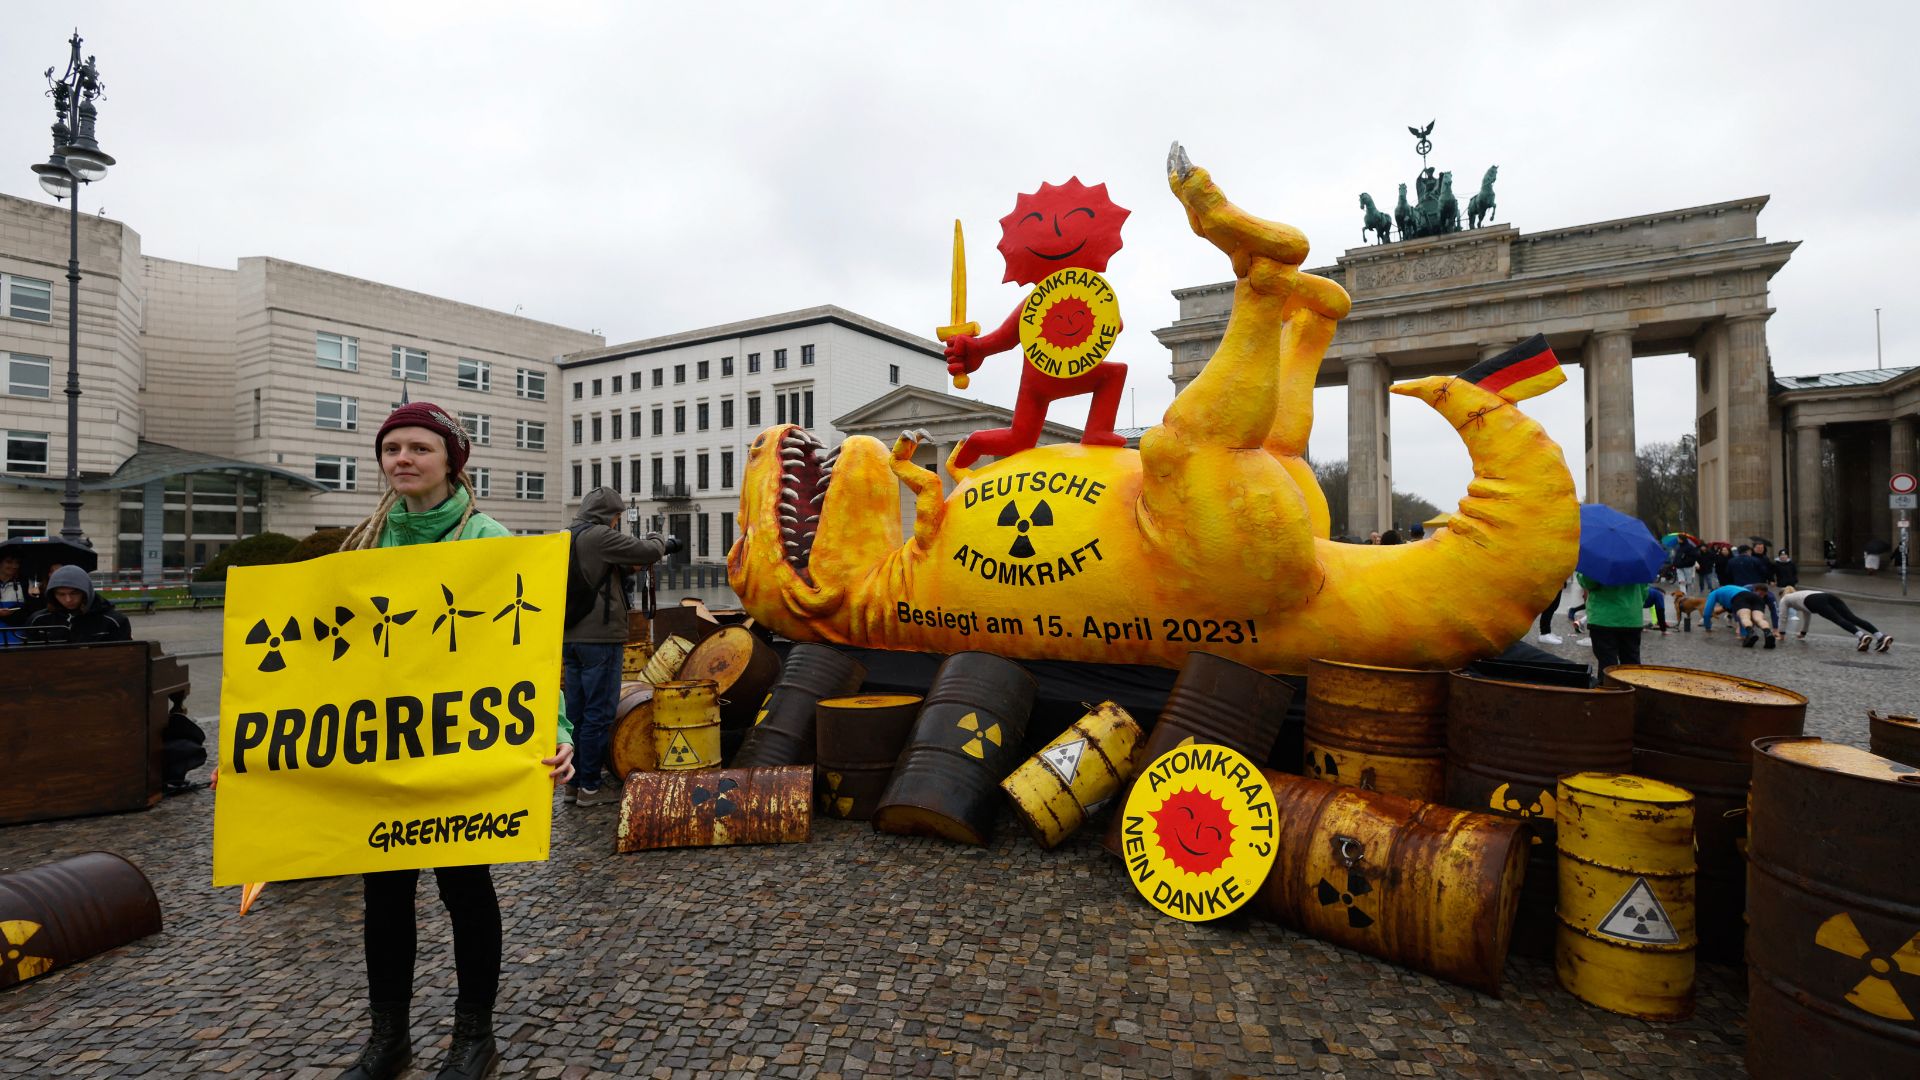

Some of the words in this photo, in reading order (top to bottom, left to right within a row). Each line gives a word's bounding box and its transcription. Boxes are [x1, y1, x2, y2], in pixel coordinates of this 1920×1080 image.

[1023, 270, 1114, 326] ATOMKRAFT?
[1026, 342, 1063, 376] NEIN
[1068, 324, 1116, 375] DANKE
[964, 471, 1107, 509] DEUTSCHE
[952, 538, 1103, 587] ATOMKRAFT
[897, 601, 979, 636] Besiegt
[986, 616, 1023, 635] am
[1033, 614, 1072, 637] 15.
[1082, 615, 1153, 645] April
[1162, 618, 1259, 644] 2023!
[232, 680, 536, 774] PROGRESS
[1148, 749, 1273, 857] ATOMKRAFT?
[368, 809, 529, 852] GREENPEACE
[1125, 816, 1155, 883] NEIN
[1152, 876, 1245, 915] DANKE
